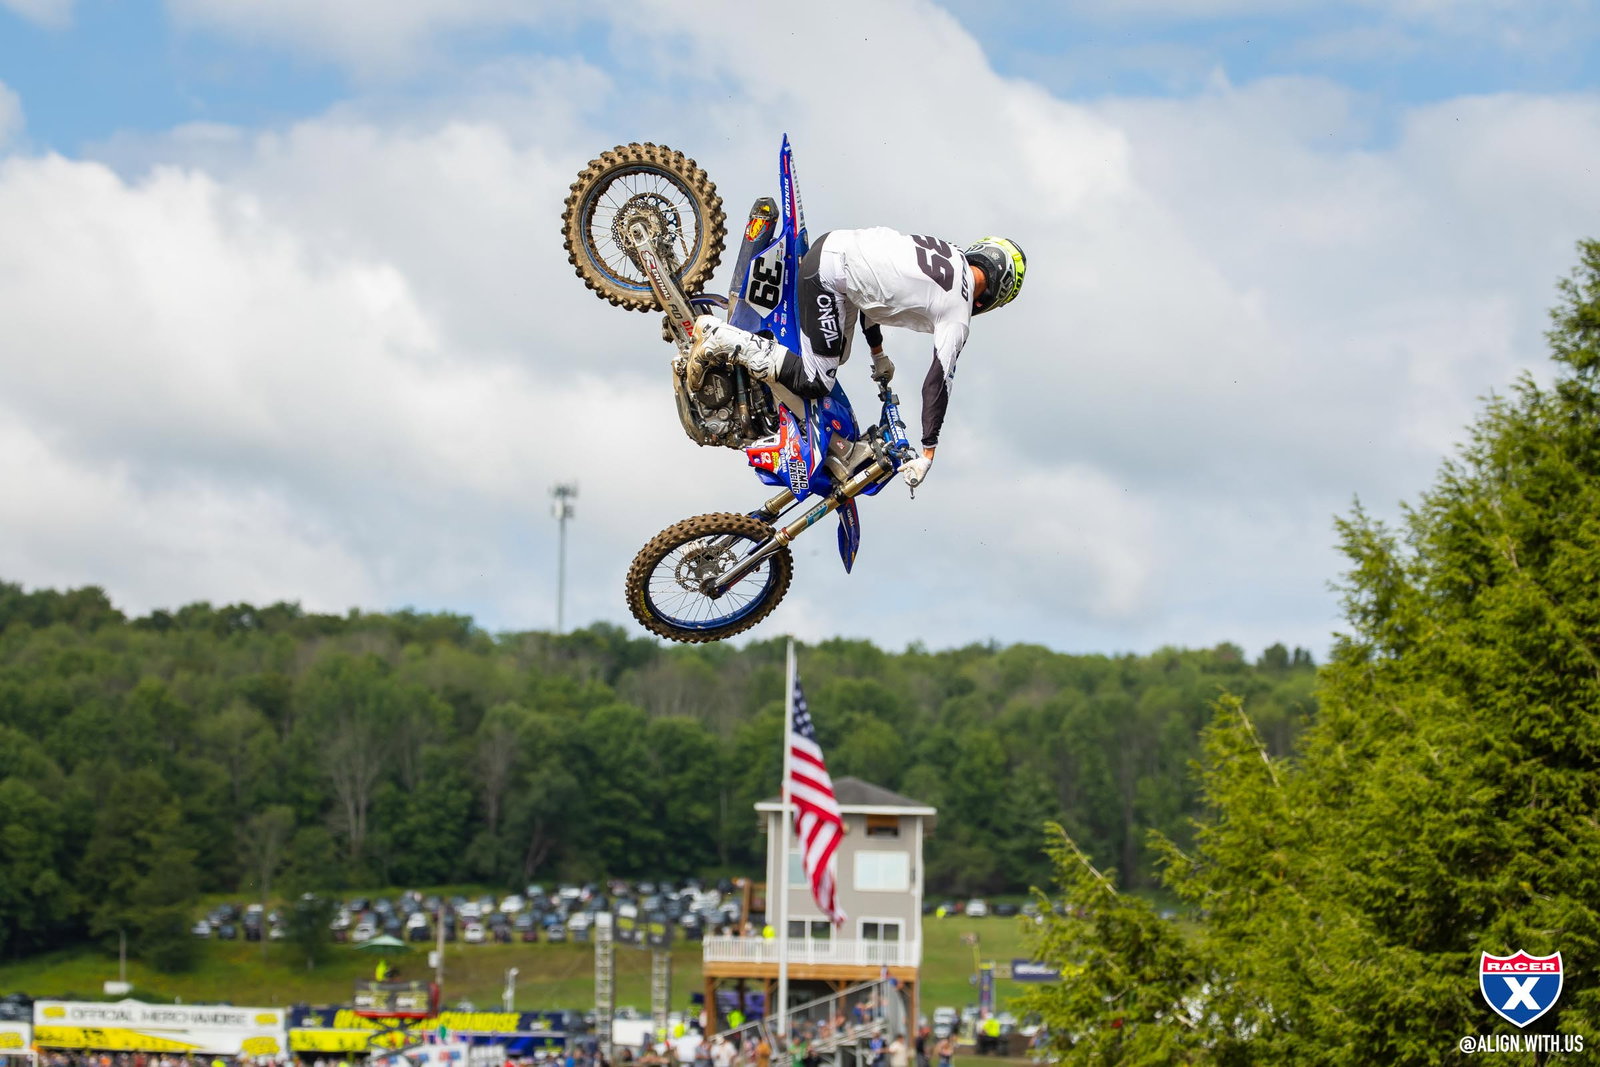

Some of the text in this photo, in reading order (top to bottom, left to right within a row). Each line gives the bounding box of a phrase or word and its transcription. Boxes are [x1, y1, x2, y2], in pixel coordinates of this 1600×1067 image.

[911, 234, 955, 293] 39
[748, 256, 783, 311] 39
[890, 406, 907, 440] RENHAL
[788, 461, 801, 494] RACING
[796, 460, 809, 489] GIZMO
